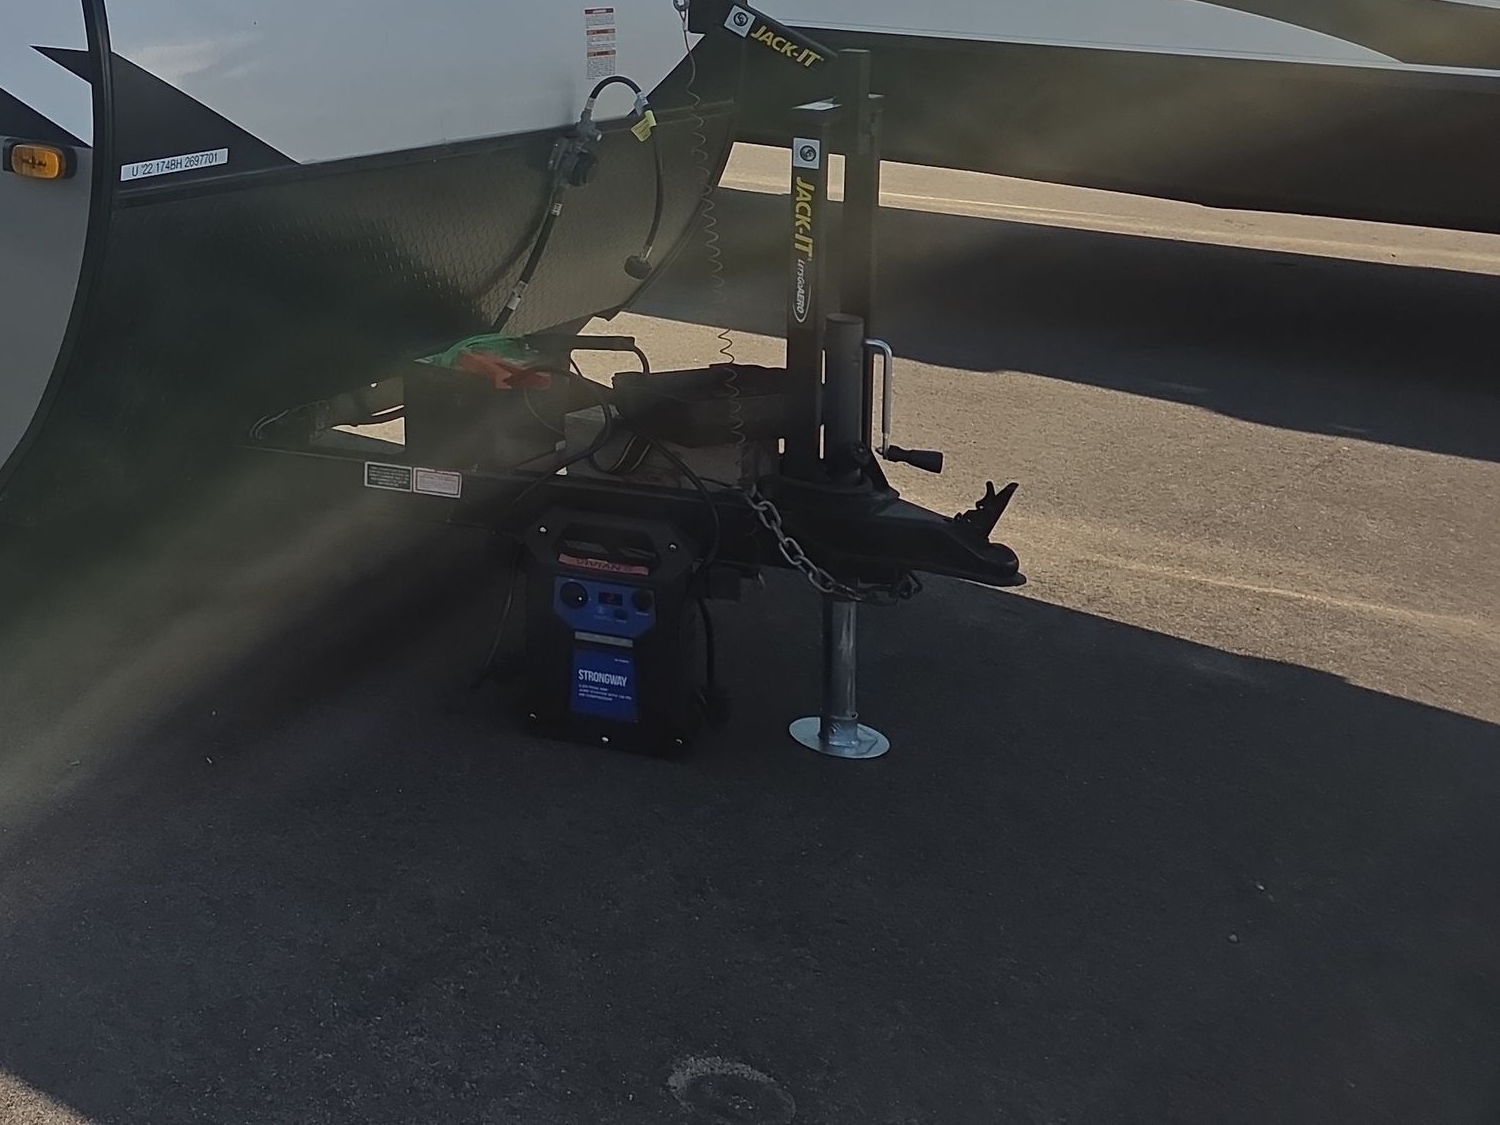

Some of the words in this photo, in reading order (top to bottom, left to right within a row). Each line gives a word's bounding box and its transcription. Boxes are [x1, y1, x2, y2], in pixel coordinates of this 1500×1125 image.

[750, 25, 822, 67] JACK-IT
[131, 166, 139, 177] U
[156, 159, 183, 173] 174BH
[184, 153, 218, 168] 2697701
[794, 176, 815, 257] JACK-IT
[578, 668, 628, 688] STRONGWAY
